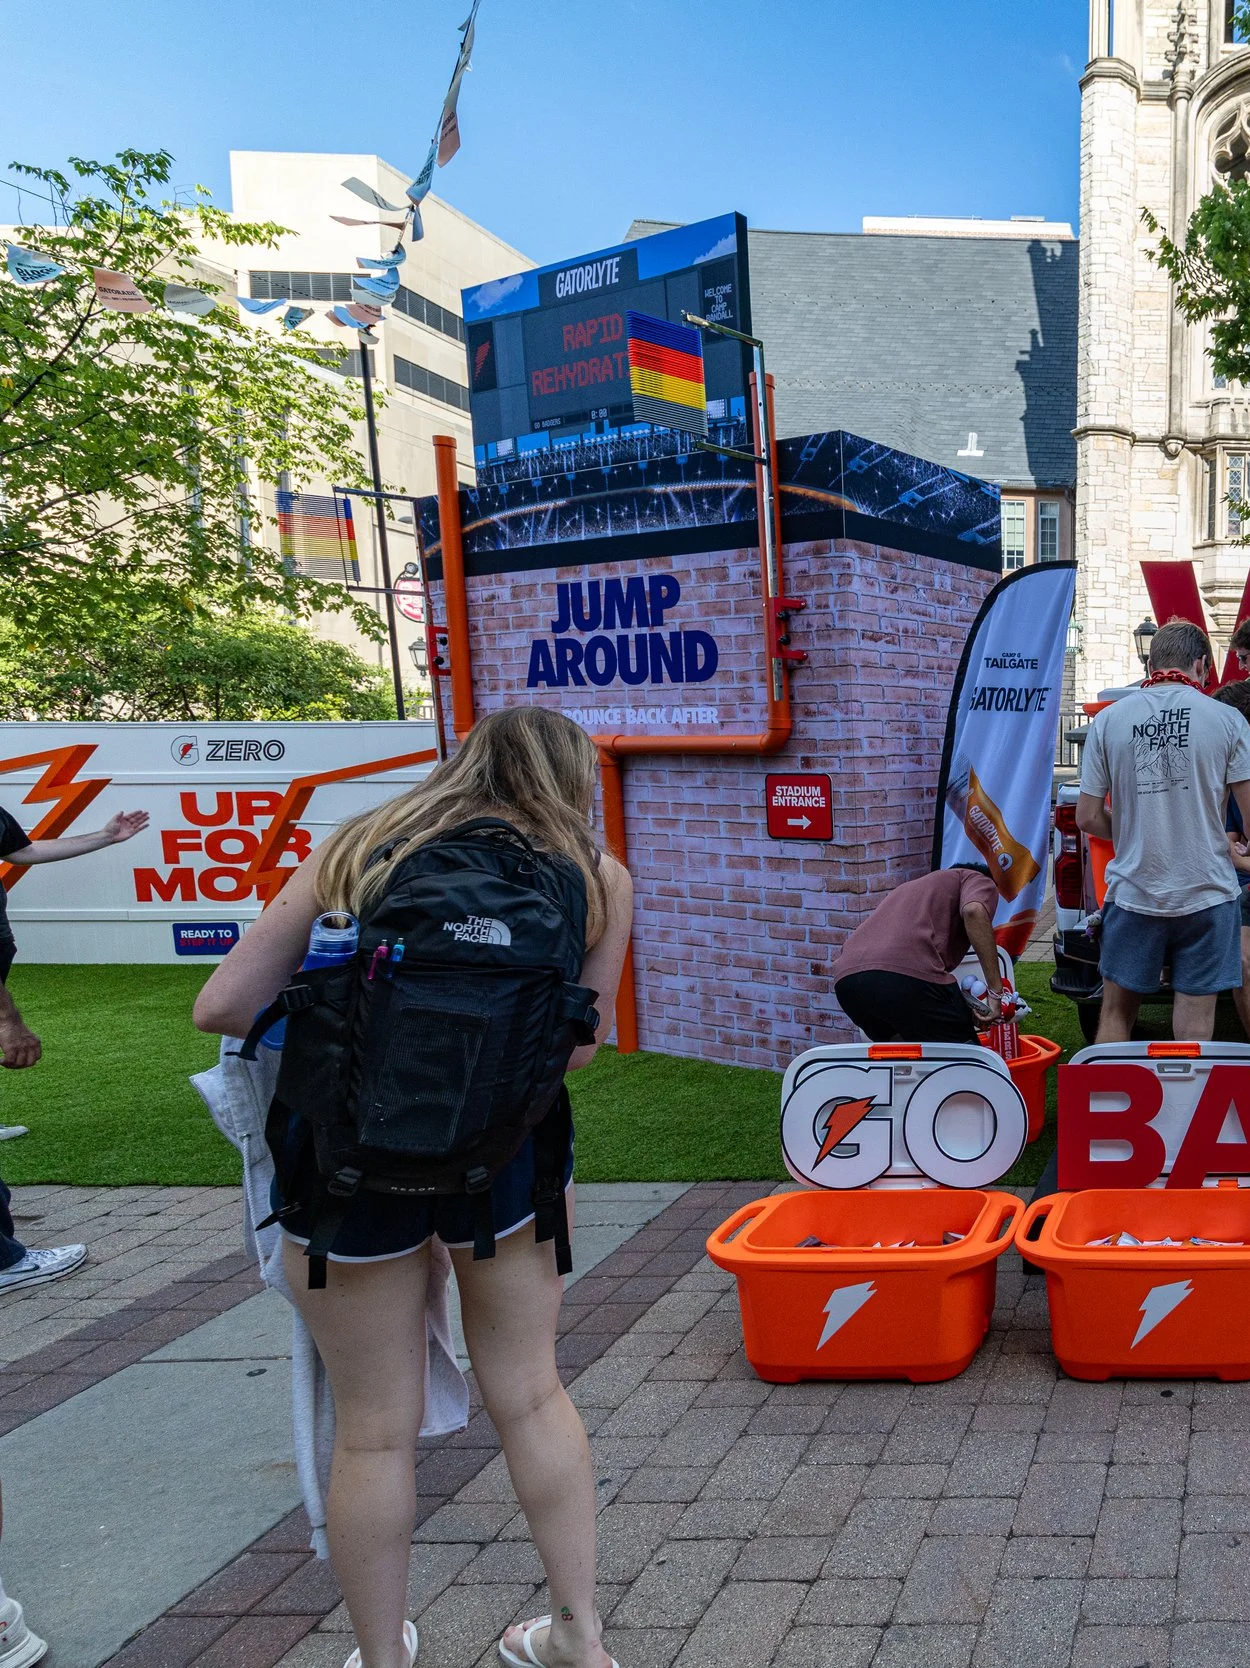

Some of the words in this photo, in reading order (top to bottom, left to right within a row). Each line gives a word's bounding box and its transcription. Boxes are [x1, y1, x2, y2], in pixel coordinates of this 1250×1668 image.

[556, 257, 621, 299] GATORLYTE
[98, 286, 137, 296] GATORADE
[704, 284, 733, 297] WELCOME
[715, 294, 723, 303] TO
[711, 302, 728, 314] CAMP
[562, 313, 624, 352] RAPID
[532, 352, 630, 397] REHYDRAT
[551, 574, 681, 633] JUMP
[527, 630, 719, 688] AROUND
[984, 658, 1038, 670] TAILGATE
[625, 707, 670, 724] BACK
[671, 706, 719, 724] AFTER
[1160, 708, 1192, 722] THE
[1133, 721, 1190, 738] NORTH
[1150, 734, 1189, 751] FACE
[206, 739, 285, 762] ZERO
[775, 785, 821, 796] STADIUM
[179, 791, 285, 827] UP
[772, 796, 826, 808] ENTRANCE
[969, 805, 1004, 853] GATORLYTE
[160, 829, 313, 865] FOR
[442, 921, 491, 935] NORTH
[466, 915, 493, 927] THE
[180, 930, 215, 939] READY
[217, 930, 233, 939] TO
[453, 931, 490, 944] FACE
[179, 938, 204, 947] STEP
[207, 938, 217, 947] IT
[219, 938, 234, 947] UP
[780, 1063, 1029, 1189] GO
